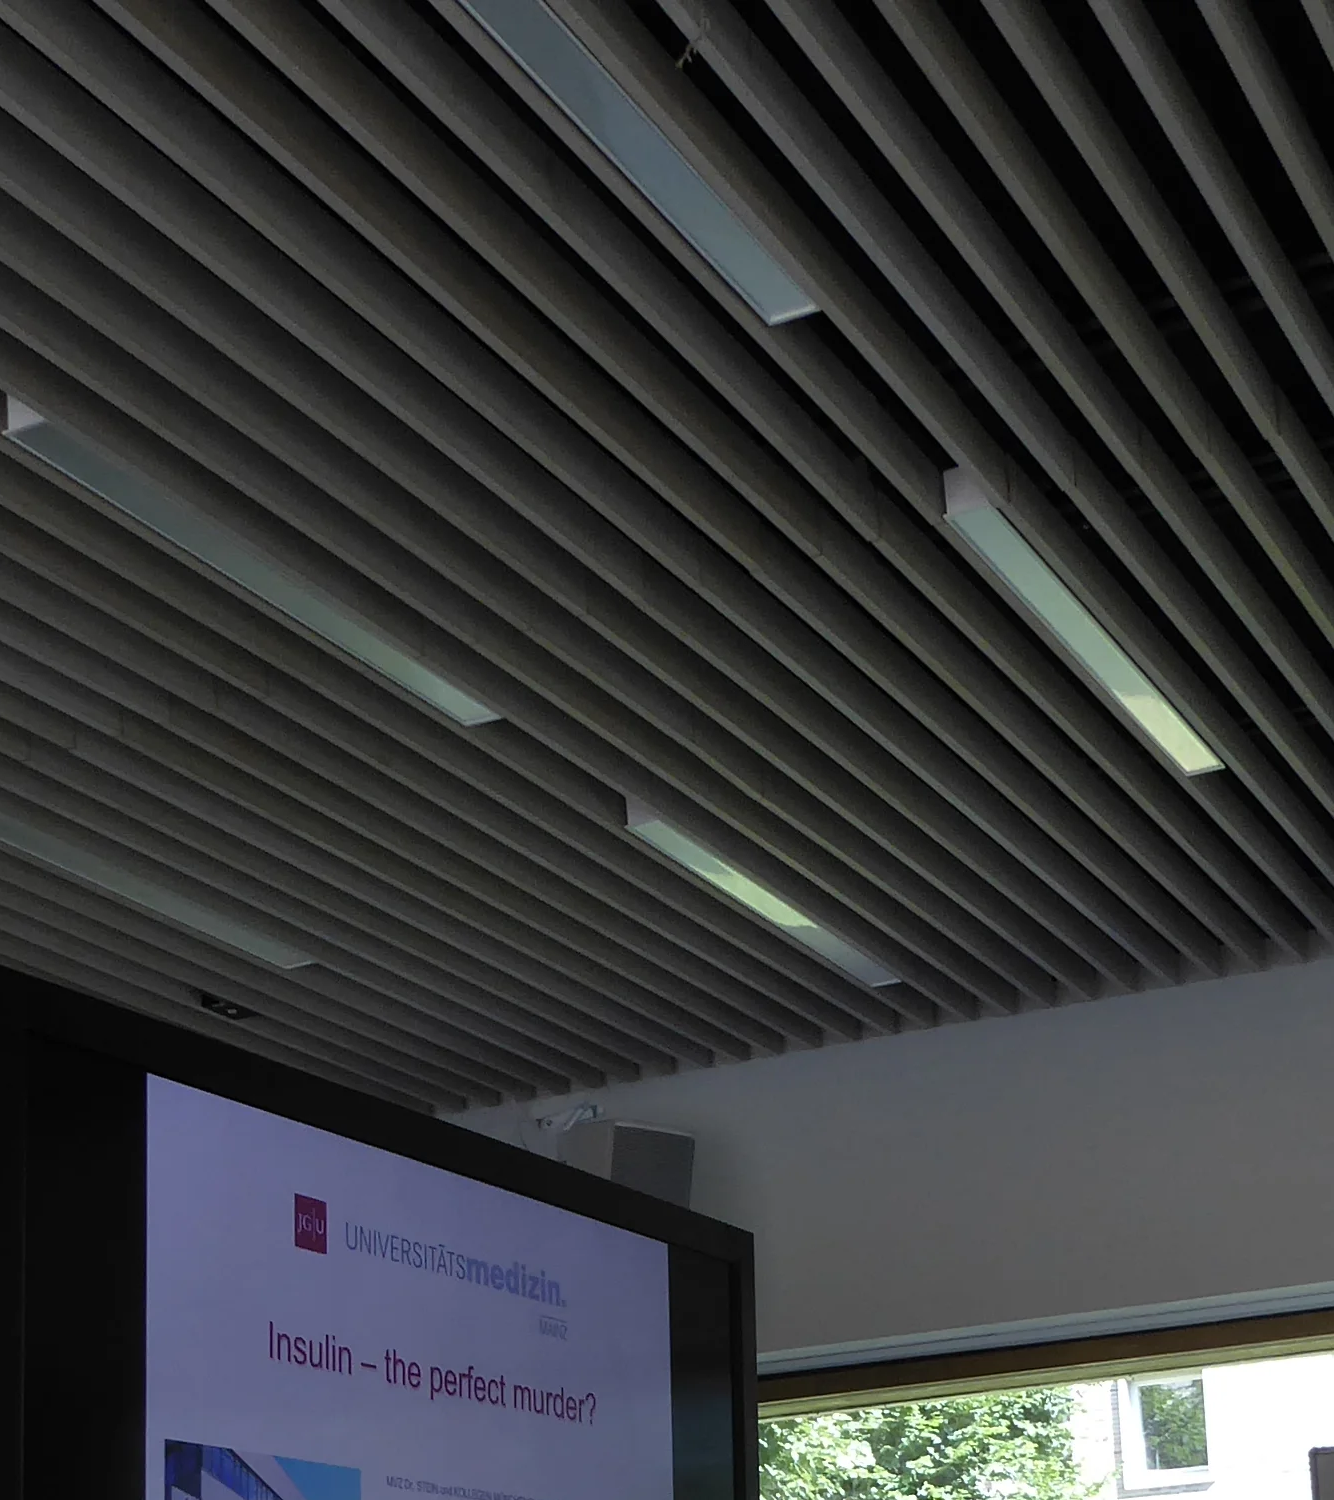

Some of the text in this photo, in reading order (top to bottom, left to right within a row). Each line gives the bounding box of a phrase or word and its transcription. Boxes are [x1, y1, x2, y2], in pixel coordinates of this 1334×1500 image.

[269, 1321, 352, 1375] Insulin
[385, 1349, 421, 1388] the
[430, 1365, 506, 1407] perfect
[513, 1384, 597, 1425] murder?
